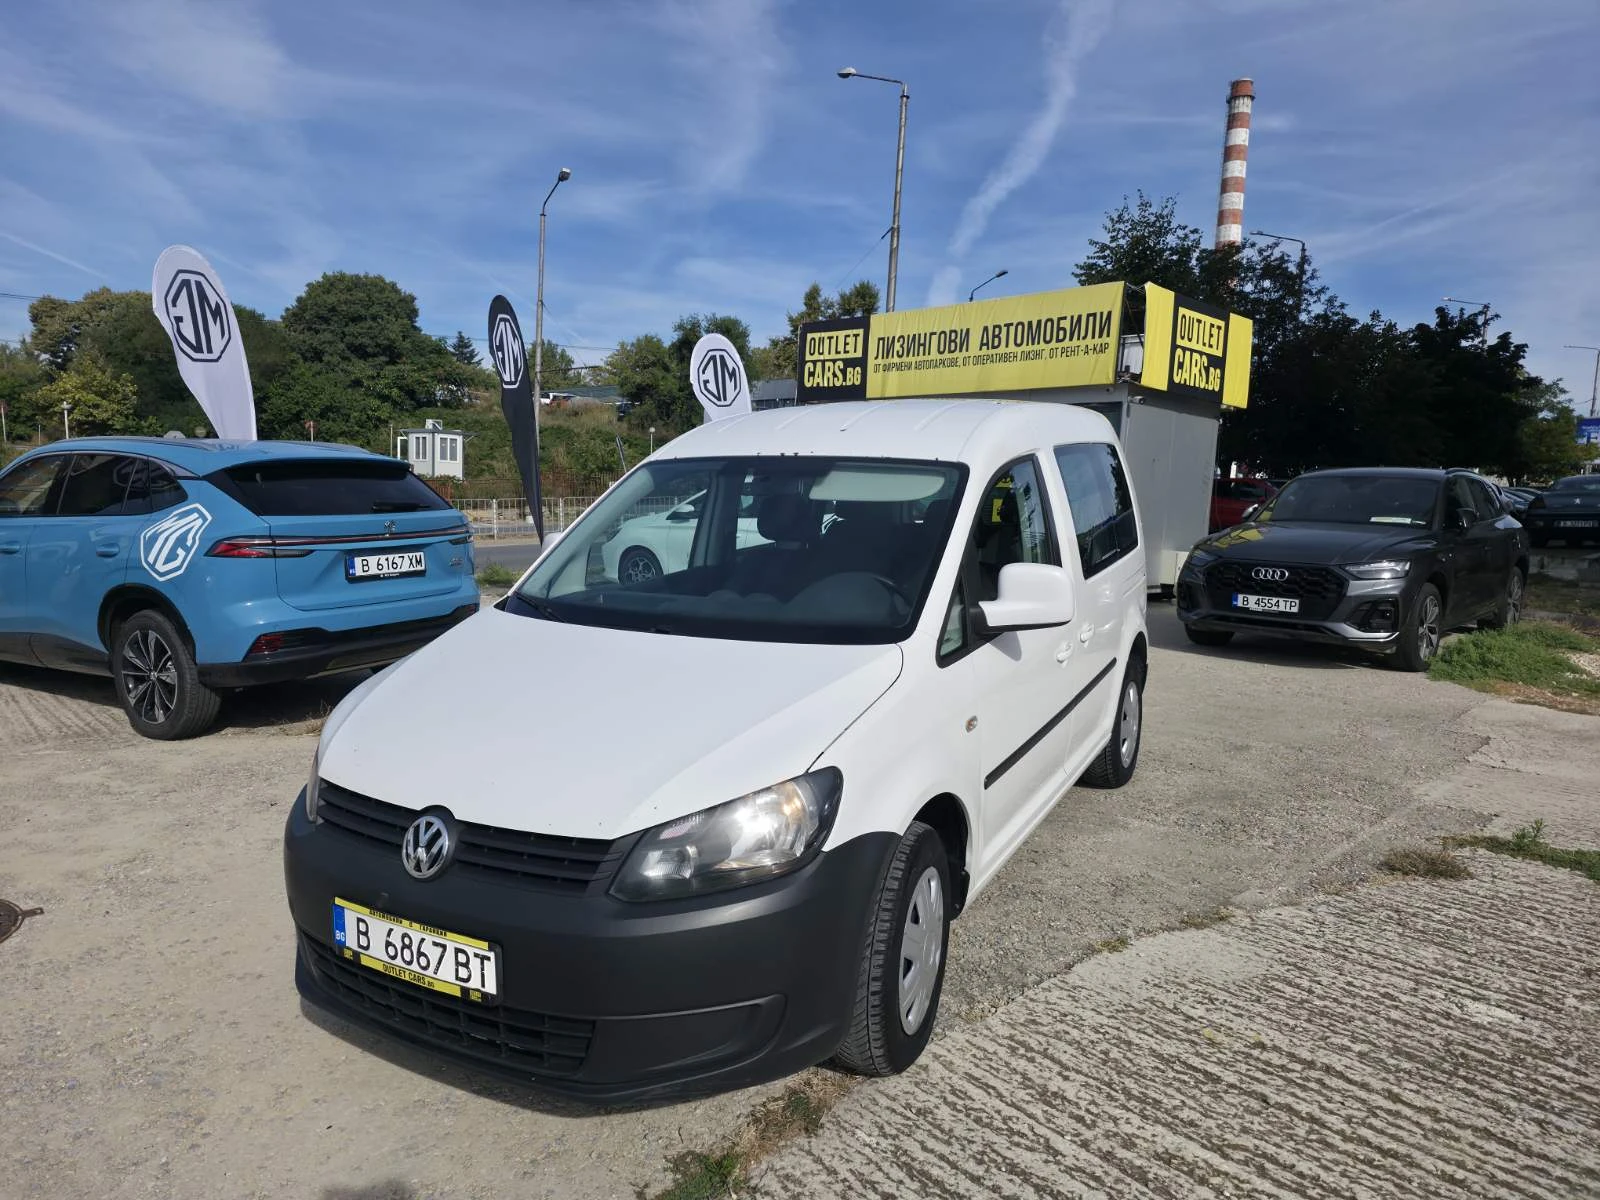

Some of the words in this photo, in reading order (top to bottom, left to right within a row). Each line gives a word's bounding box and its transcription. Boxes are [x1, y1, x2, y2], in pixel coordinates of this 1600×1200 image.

[808, 333, 860, 357] OUTLET
[874, 329, 970, 360] ЛИЗИНГОВИ
[979, 310, 1112, 351] АВТОМОБИЛИ
[1180, 313, 1222, 350] OUTLET
[873, 363, 882, 374] ОТ
[882, 361, 913, 373] ФИРМЕНИ
[962, 355, 971, 367] ОТ
[972, 351, 1018, 366] ОПЕРАТИВЕН
[1049, 347, 1060, 359] ОТ
[1060, 342, 1110, 358] РЕНТ-А-КАР
[1173, 348, 1221, 392] CARS.BG
[803, 361, 862, 388] CARS.BG
[144, 510, 203, 573] MG
[361, 559, 370, 573] B
[376, 555, 406, 572] 6167
[407, 554, 423, 569] XM
[1242, 596, 1249, 606] B
[1254, 598, 1280, 608] 4554
[1282, 599, 1297, 610] TP
[356, 917, 371, 951] B
[384, 927, 448, 975] 6867
[454, 946, 492, 989] BT
[382, 963, 407, 979] OUTLET
